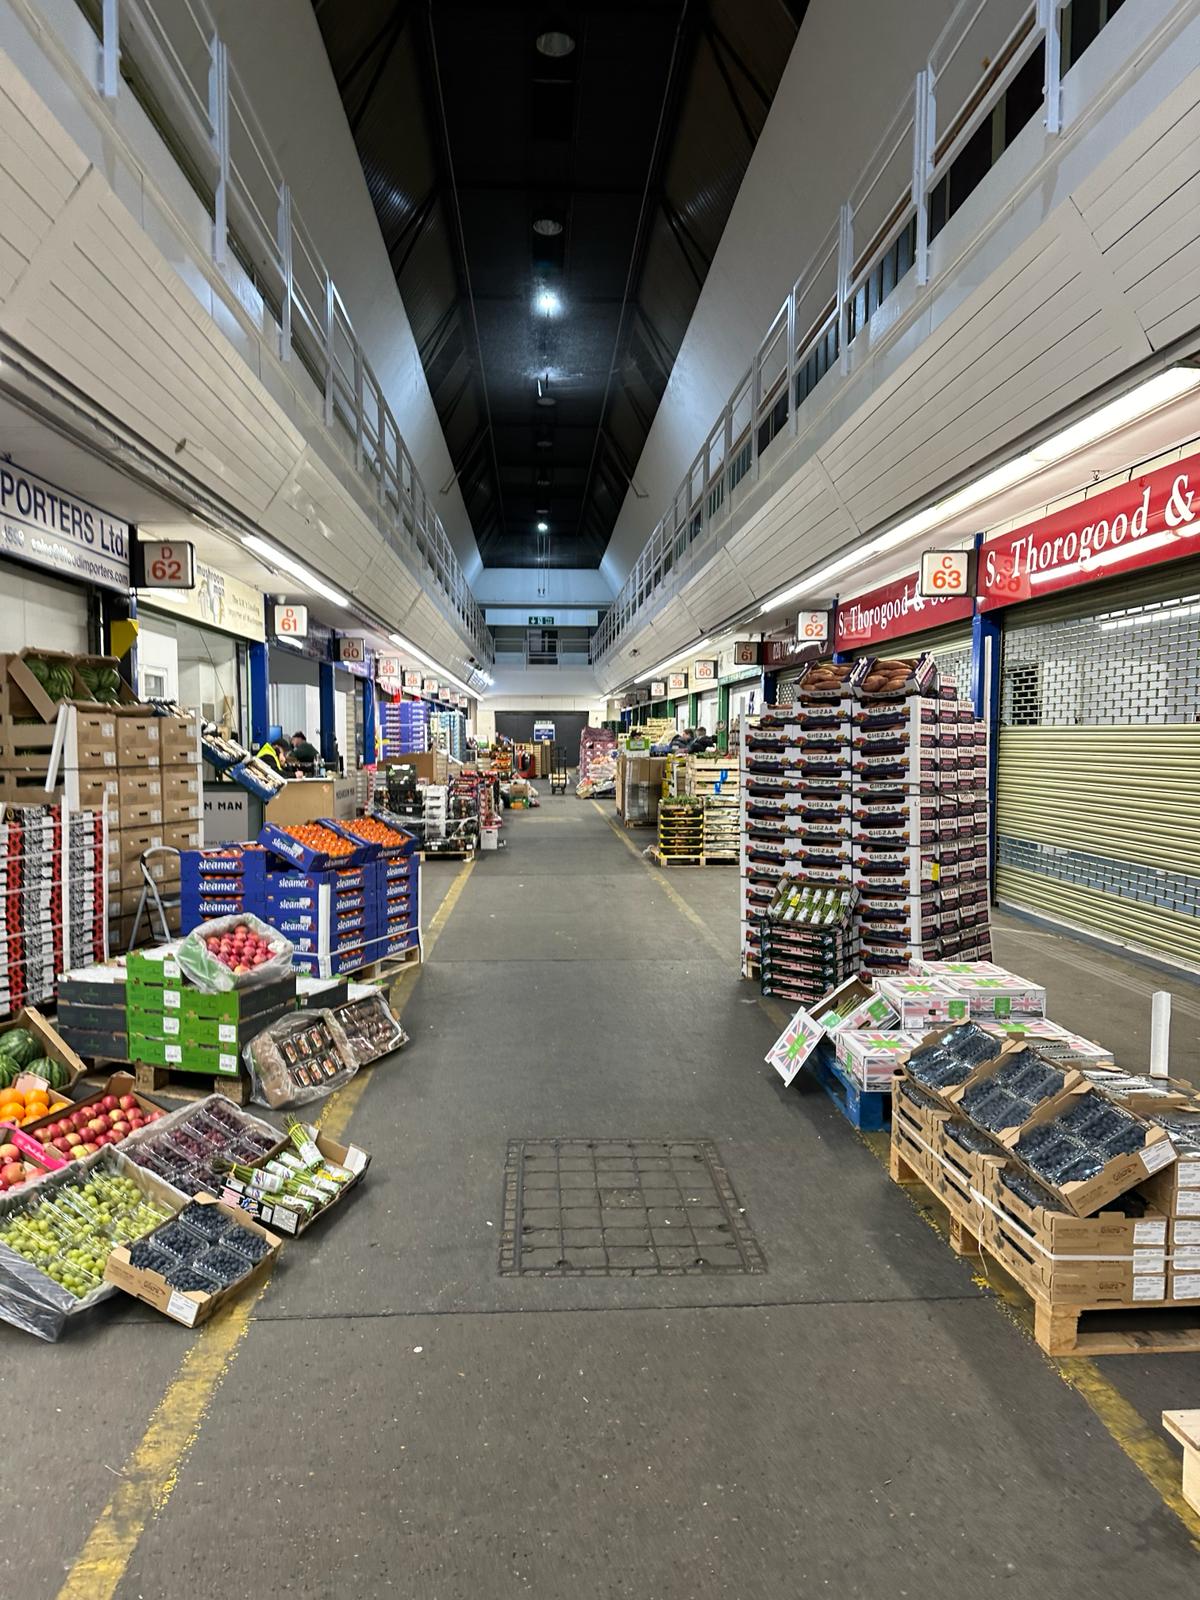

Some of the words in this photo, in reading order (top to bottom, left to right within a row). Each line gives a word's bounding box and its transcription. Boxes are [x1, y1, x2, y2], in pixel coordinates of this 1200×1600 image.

[0, 469, 94, 544] PORTERS
[100, 518, 128, 559] Ltd.
[985, 550, 1001, 588] S.
[1010, 486, 1151, 571] Thorogood
[1165, 474, 1196, 527] &
[162, 546, 172, 560] D
[942, 556, 953, 569] C
[152, 560, 181, 580] 62
[933, 570, 961, 589] 63
[286, 608, 294, 617] D
[838, 611, 847, 636] S.
[850, 584, 908, 631] Thorogood
[281, 618, 297, 632] 61
[811, 614, 818, 623] C
[805, 624, 824, 637] 62
[343, 648, 359, 658] 60
[741, 651, 753, 661] 61
[699, 668, 711, 676] 60
[867, 756, 896, 764] GHEZAA
[218, 802, 243, 811] MAN
[871, 947, 899, 955] GHEZAA
